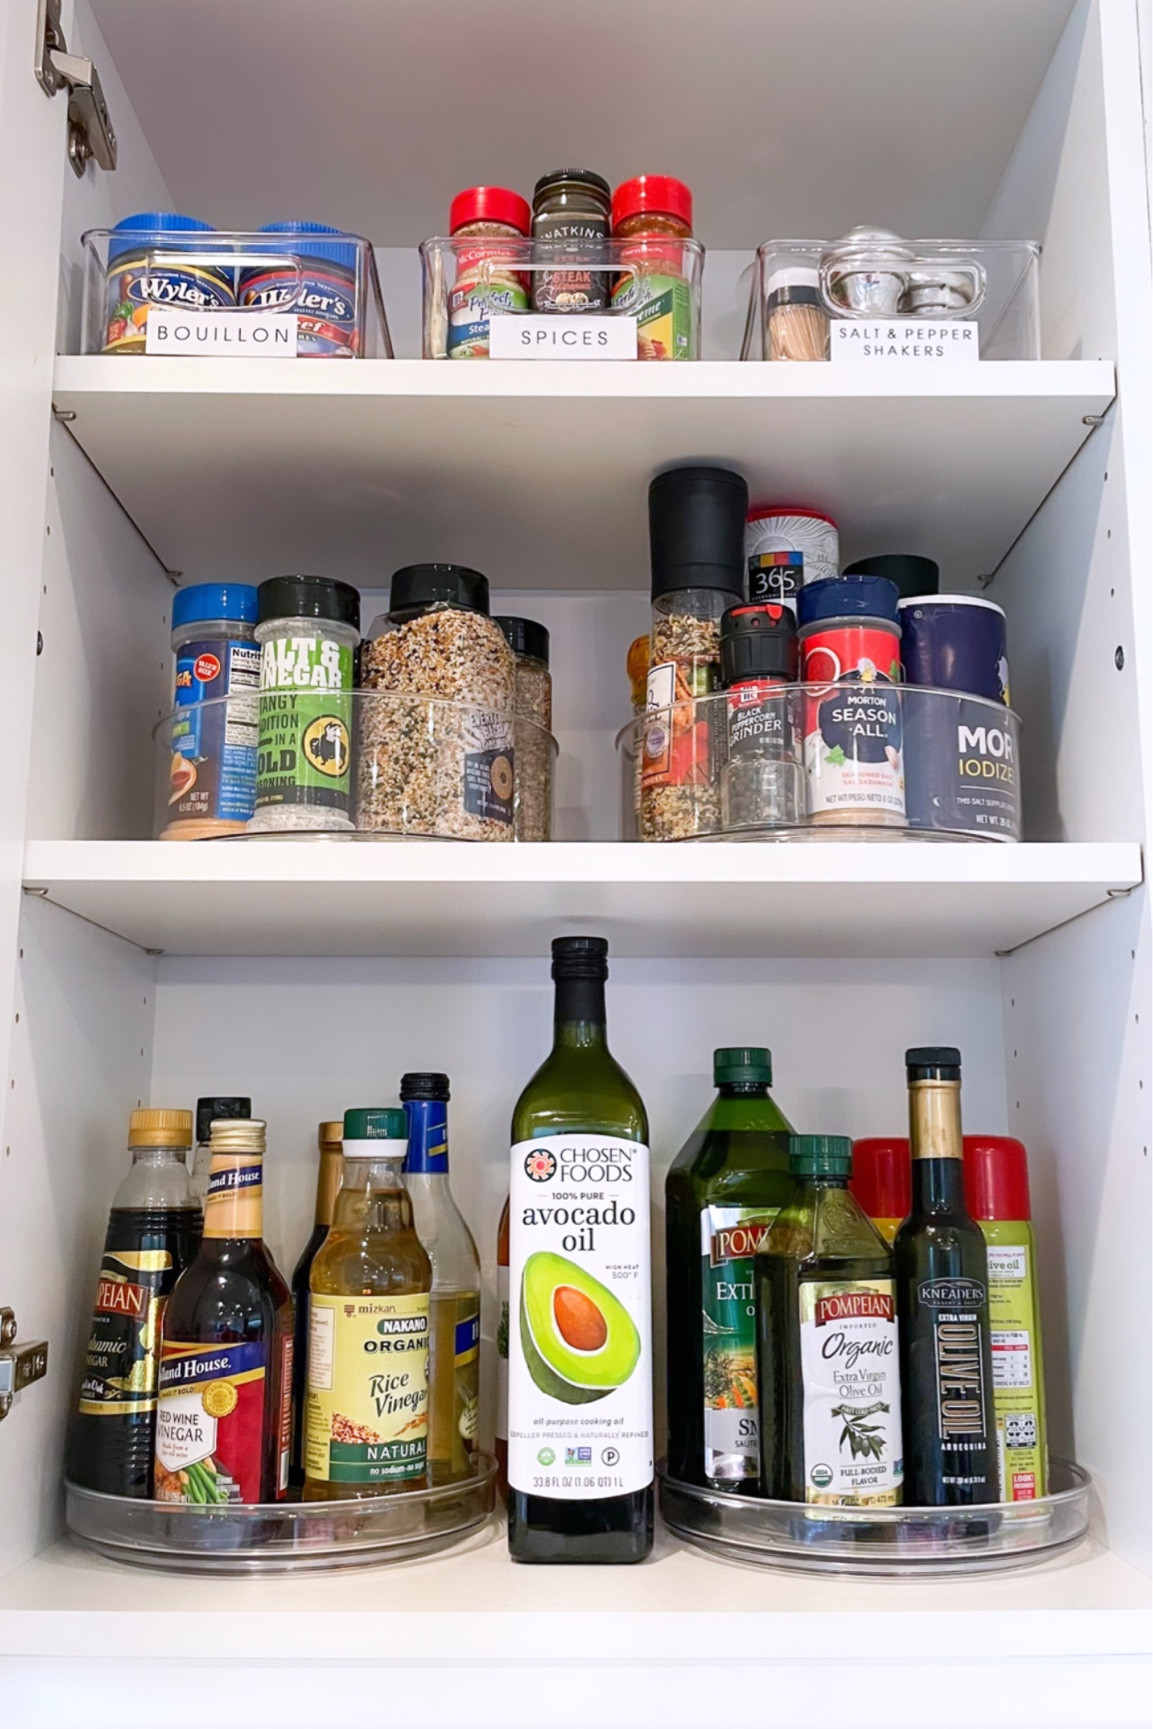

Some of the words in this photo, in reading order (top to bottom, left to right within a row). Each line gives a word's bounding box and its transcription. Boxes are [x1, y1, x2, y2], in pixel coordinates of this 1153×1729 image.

[553, 271, 591, 283] STEAK
[140, 277, 220, 308] Wyler's
[260, 288, 346, 315] Wler's
[157, 325, 290, 343] BOUILLON
[469, 323, 490, 335] Stea
[839, 328, 881, 339] SALT
[887, 328, 897, 339] &
[905, 329, 973, 340] PEPPER
[521, 330, 609, 346] SPICES
[863, 345, 945, 356] SHAKERS
[755, 567, 795, 594] 365
[232, 648, 261, 661] Nutrit
[260, 637, 317, 667] ALT
[320, 640, 340, 667] &
[847, 696, 886, 707] MORTON
[738, 707, 762, 721] BLACK
[831, 708, 897, 725] SEASON
[274, 733, 285, 746] IN
[289, 732, 297, 745] A
[957, 725, 1014, 764] MOR
[257, 749, 297, 777] OLD
[958, 758, 1015, 785] IODIZE
[559, 1147, 632, 1163] CHOSEN
[228, 1171, 260, 1186] House
[560, 1164, 633, 1182] FOODS
[552, 1192, 578, 1200] 100%
[580, 1192, 605, 1200] PURE
[522, 1200, 636, 1226] avocado
[562, 1227, 596, 1252] oil
[719, 1228, 764, 1257] POM
[1007, 1259, 1020, 1270] oil
[96, 1282, 144, 1313] PEIAN
[922, 1287, 984, 1299] KNEADERS
[821, 1296, 891, 1320] POMPEIAN
[383, 1318, 426, 1333] NAKANO
[821, 1332, 894, 1369] Organic
[937, 1323, 980, 1395] OLIVE
[832, 1370, 858, 1383] Extra
[858, 1369, 886, 1383] Virgin
[368, 1373, 410, 1397] Rice
[839, 1384, 866, 1397] Olive
[867, 1383, 883, 1395] Oil
[160, 1410, 172, 1423] RED
[172, 1412, 199, 1426] WINE
[580, 1417, 612, 1427] cooking
[613, 1417, 625, 1425] oil
[941, 1399, 983, 1440] OIL
[157, 1425, 204, 1443] VINEGAR
[542, 1431, 572, 1439] PRESSED
[574, 1431, 579, 1439] &
[580, 1431, 619, 1439] NATURALLY
[621, 1430, 649, 1438] REFINED
[367, 1440, 426, 1460] NATURAL
[533, 1477, 551, 1488] 33.8
[552, 1477, 560, 1487] FL
[562, 1477, 573, 1487] OZ
[574, 1477, 595, 1488] (1.06
[597, 1477, 611, 1487] QT)
[619, 1478, 624, 1487] L
[851, 1476, 878, 1486] FLAVOR
